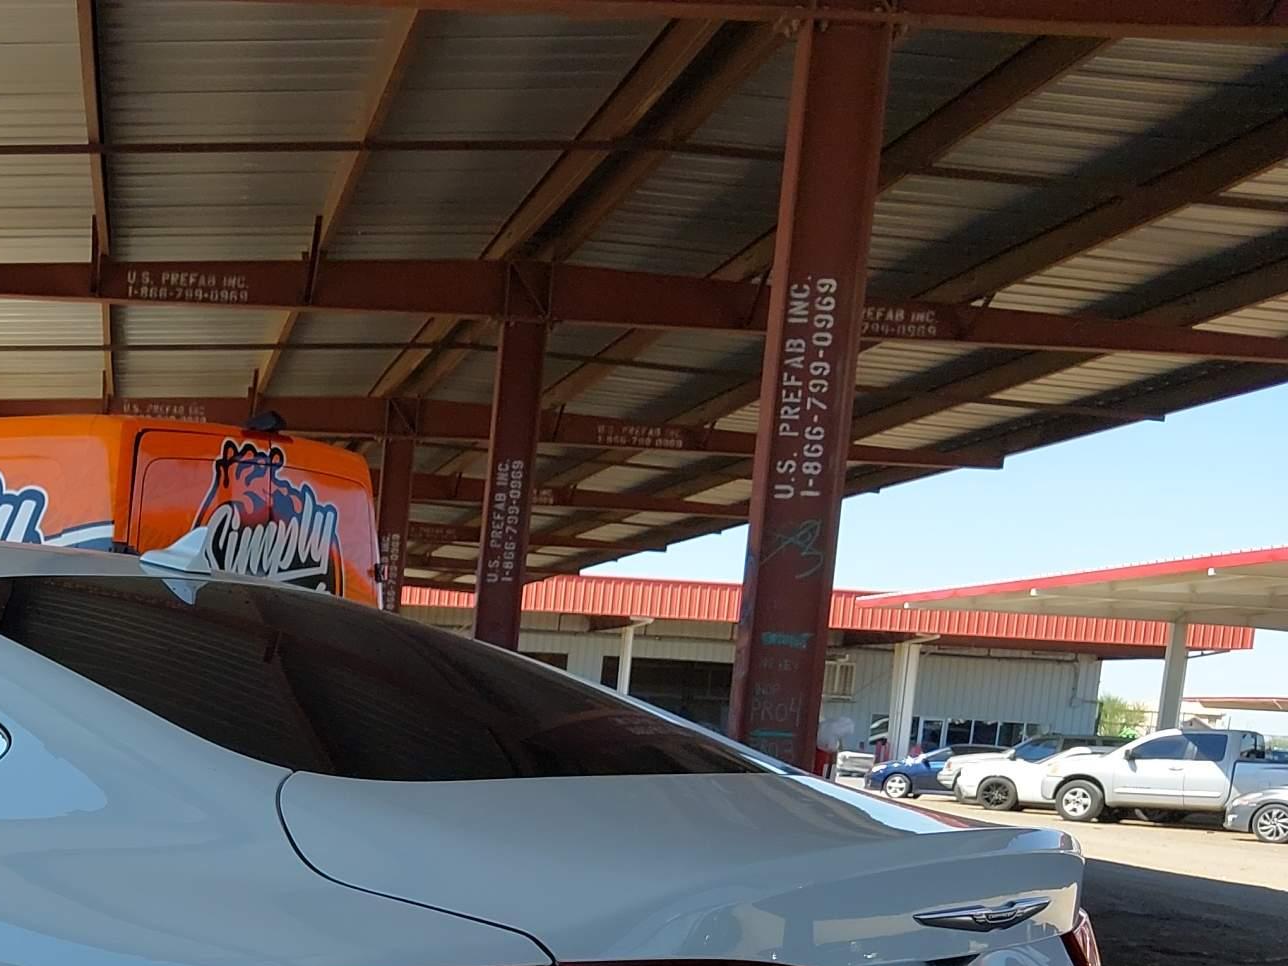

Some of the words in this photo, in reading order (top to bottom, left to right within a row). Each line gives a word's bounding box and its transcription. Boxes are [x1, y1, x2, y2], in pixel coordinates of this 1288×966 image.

[161, 271, 217, 288] PREFAB
[787, 276, 812, 324] INC.
[779, 338, 807, 437] PREFAB
[800, 278, 838, 498] 1-866-799-0969
[495, 458, 511, 486] INC.
[773, 451, 798, 499] U.S.
[205, 492, 336, 580] Simply
[490, 492, 508, 548] PREFAB
[500, 460, 525, 583] 1-866-799-0969
[486, 554, 501, 583] U.S.
